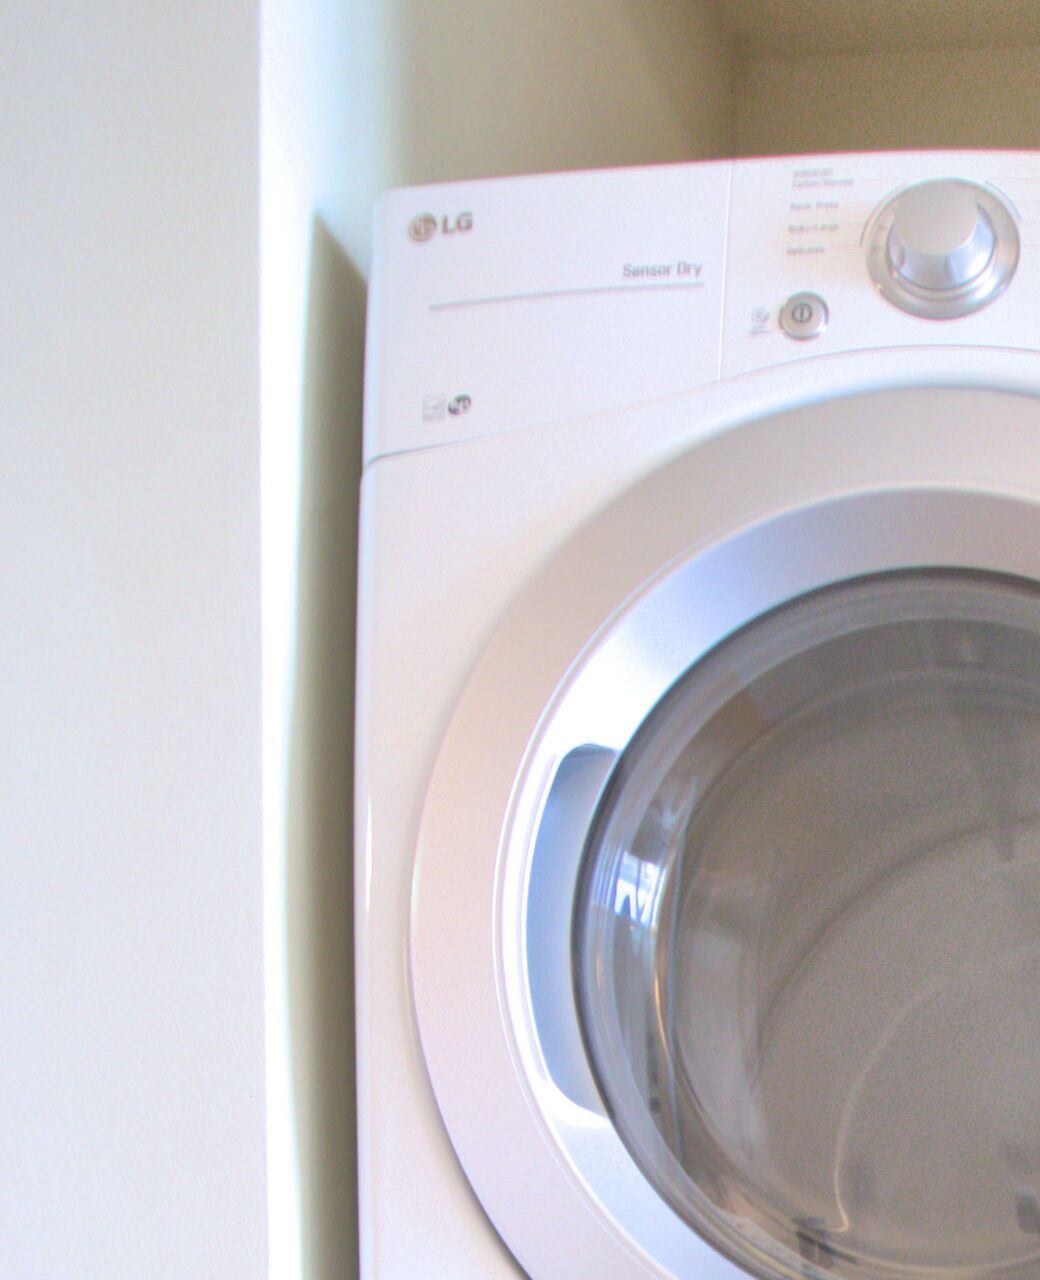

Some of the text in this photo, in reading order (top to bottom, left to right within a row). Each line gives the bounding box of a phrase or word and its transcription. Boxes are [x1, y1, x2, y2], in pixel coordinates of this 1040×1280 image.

[441, 211, 474, 235] LG
[622, 261, 703, 278] Sensor Dry
